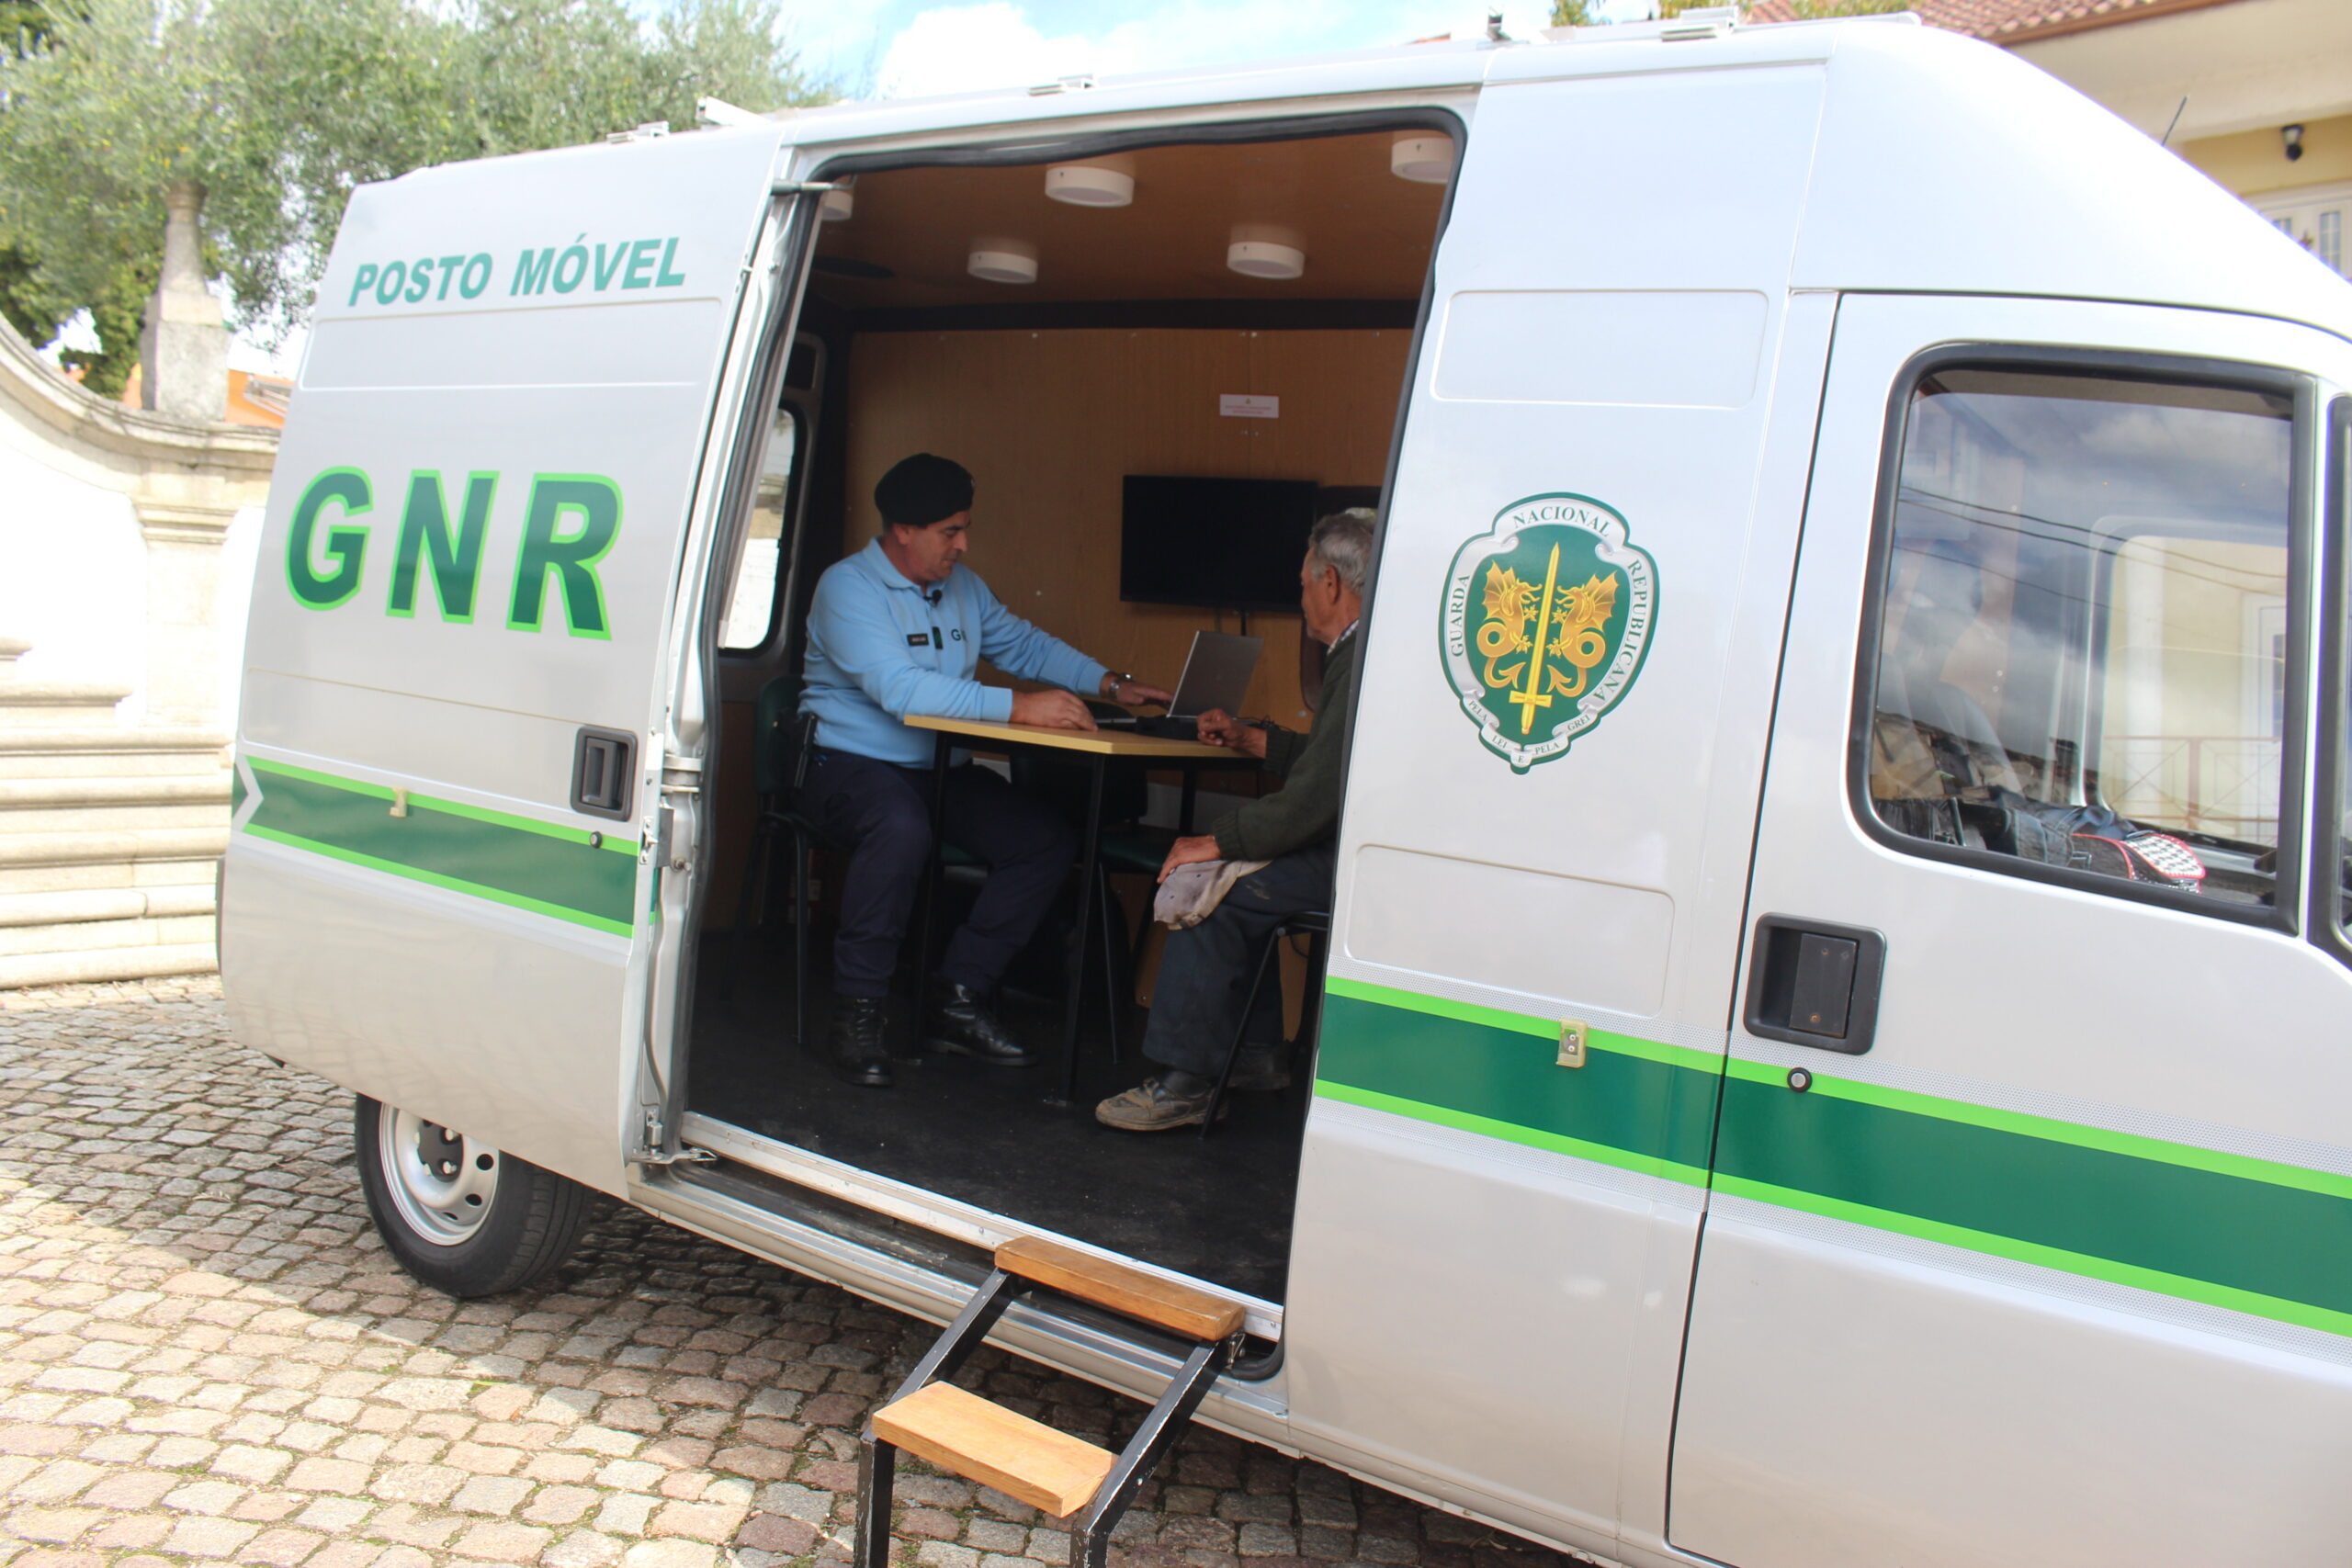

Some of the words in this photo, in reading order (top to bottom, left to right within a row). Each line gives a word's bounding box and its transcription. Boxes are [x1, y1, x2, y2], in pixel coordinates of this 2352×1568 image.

[348, 253, 492, 307] POSTO
[509, 233, 685, 296] MÓVEL
[285, 466, 624, 640] GNR
[1451, 575, 1470, 657] GUARDA
[1513, 506, 1611, 537] NACIONAL
[1594, 558, 1647, 703] REPUBLICANA
[1468, 700, 1488, 722] PELA
[1492, 734, 1508, 749] LEI
[1518, 754, 1524, 763] E
[1535, 741, 1559, 755] PELA
[1567, 714, 1591, 731] GREI
